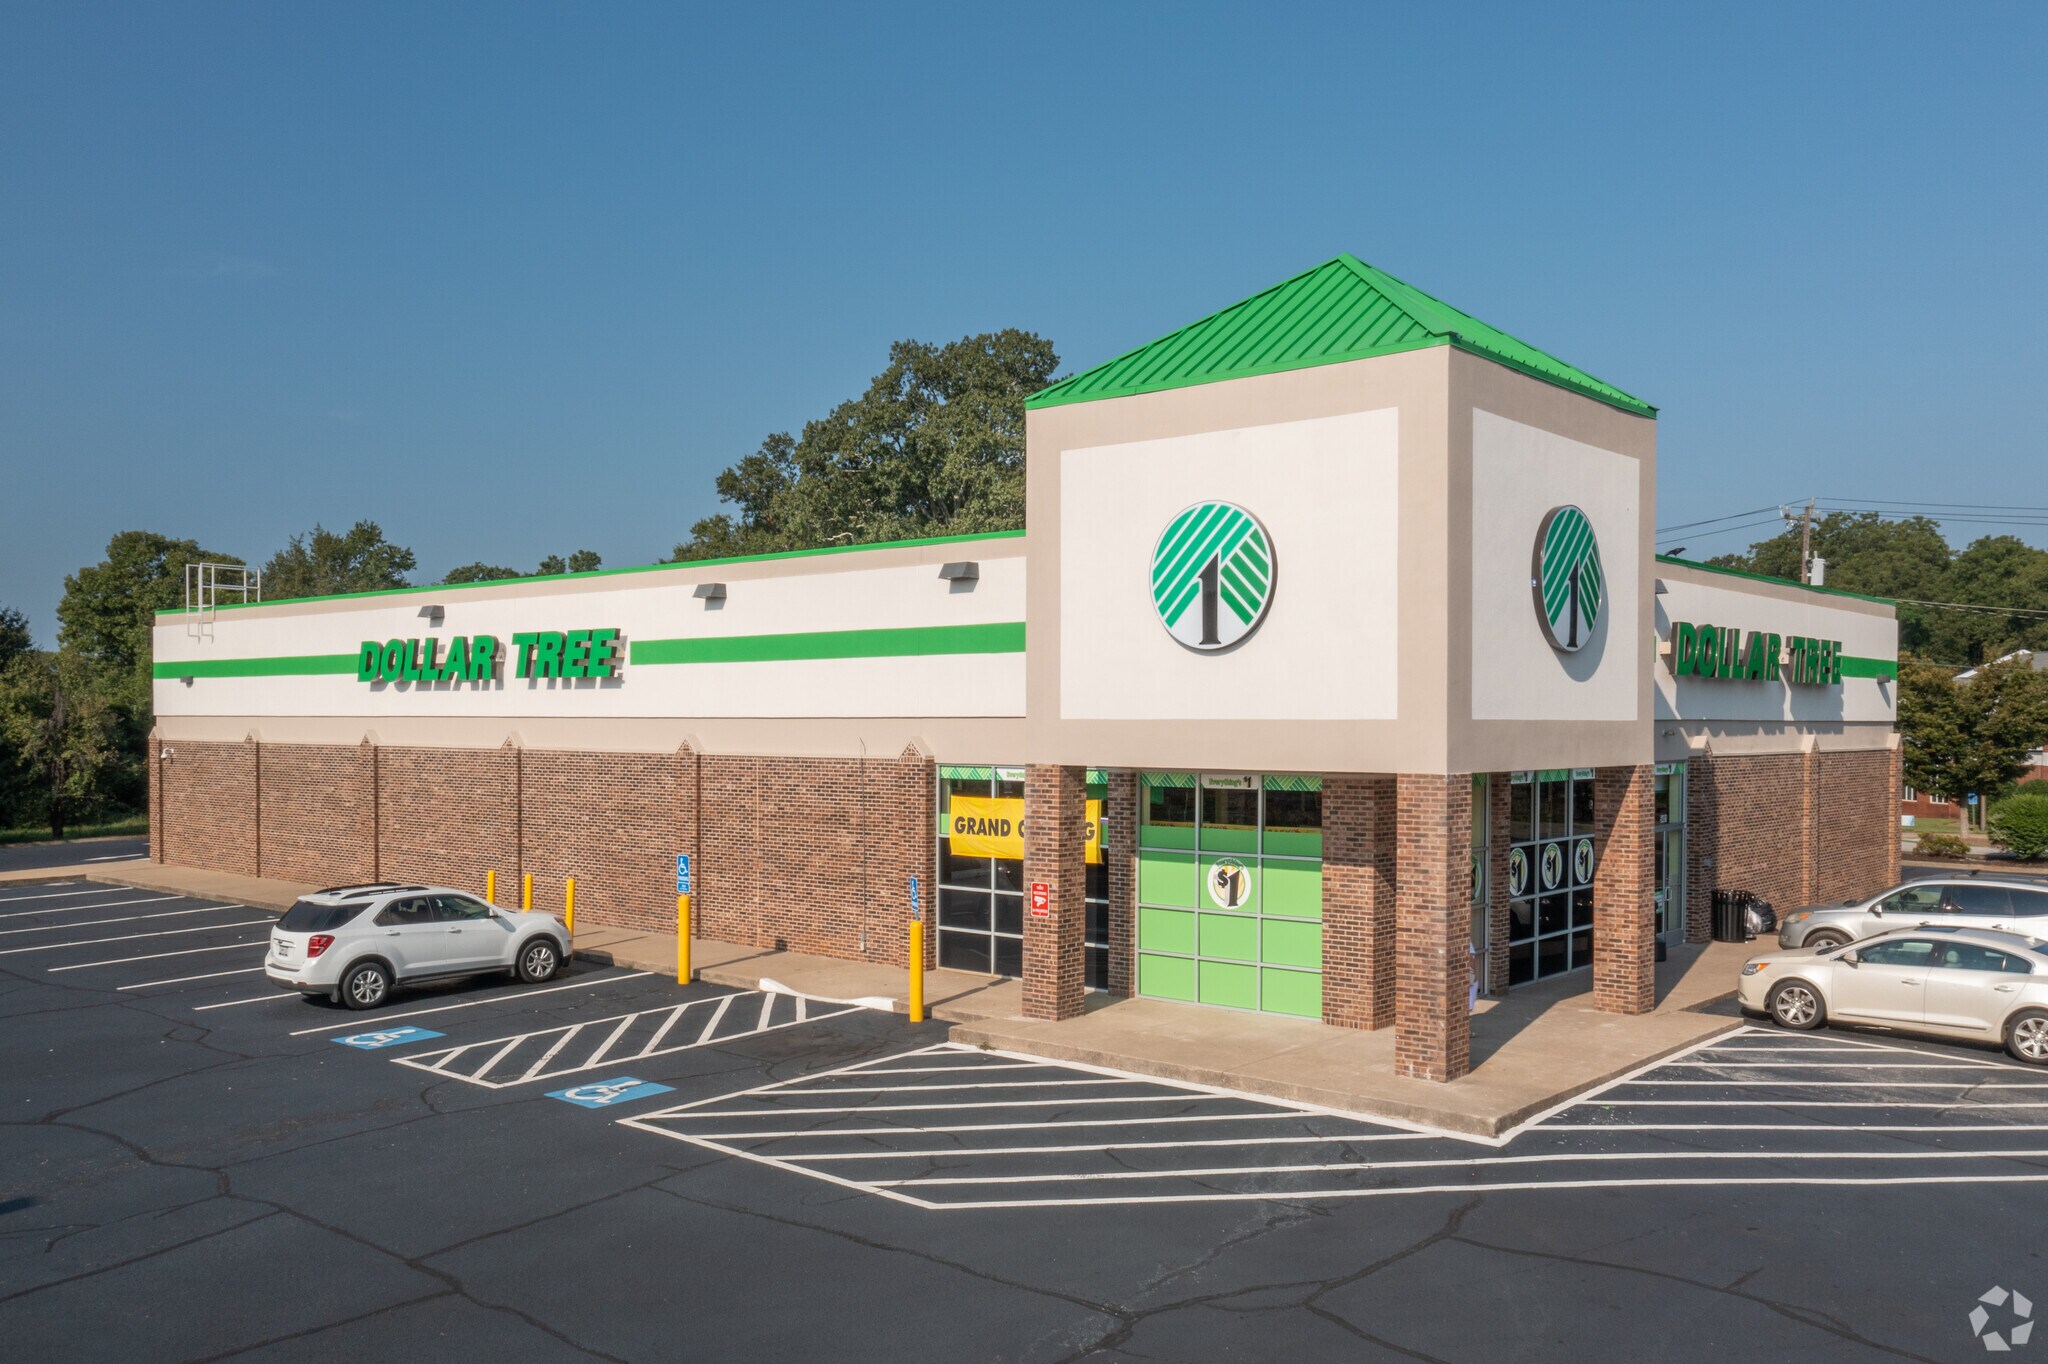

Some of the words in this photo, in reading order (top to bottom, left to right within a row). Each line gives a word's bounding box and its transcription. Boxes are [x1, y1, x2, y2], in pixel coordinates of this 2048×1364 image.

[357, 634, 499, 683] DOLLAR
[512, 628, 620, 679] TREE
[1670, 621, 1782, 682] DOLLAR
[1787, 636, 1842, 685] TREE
[954, 816, 1011, 837] GRAND
[1217, 869, 1241, 908] $1
